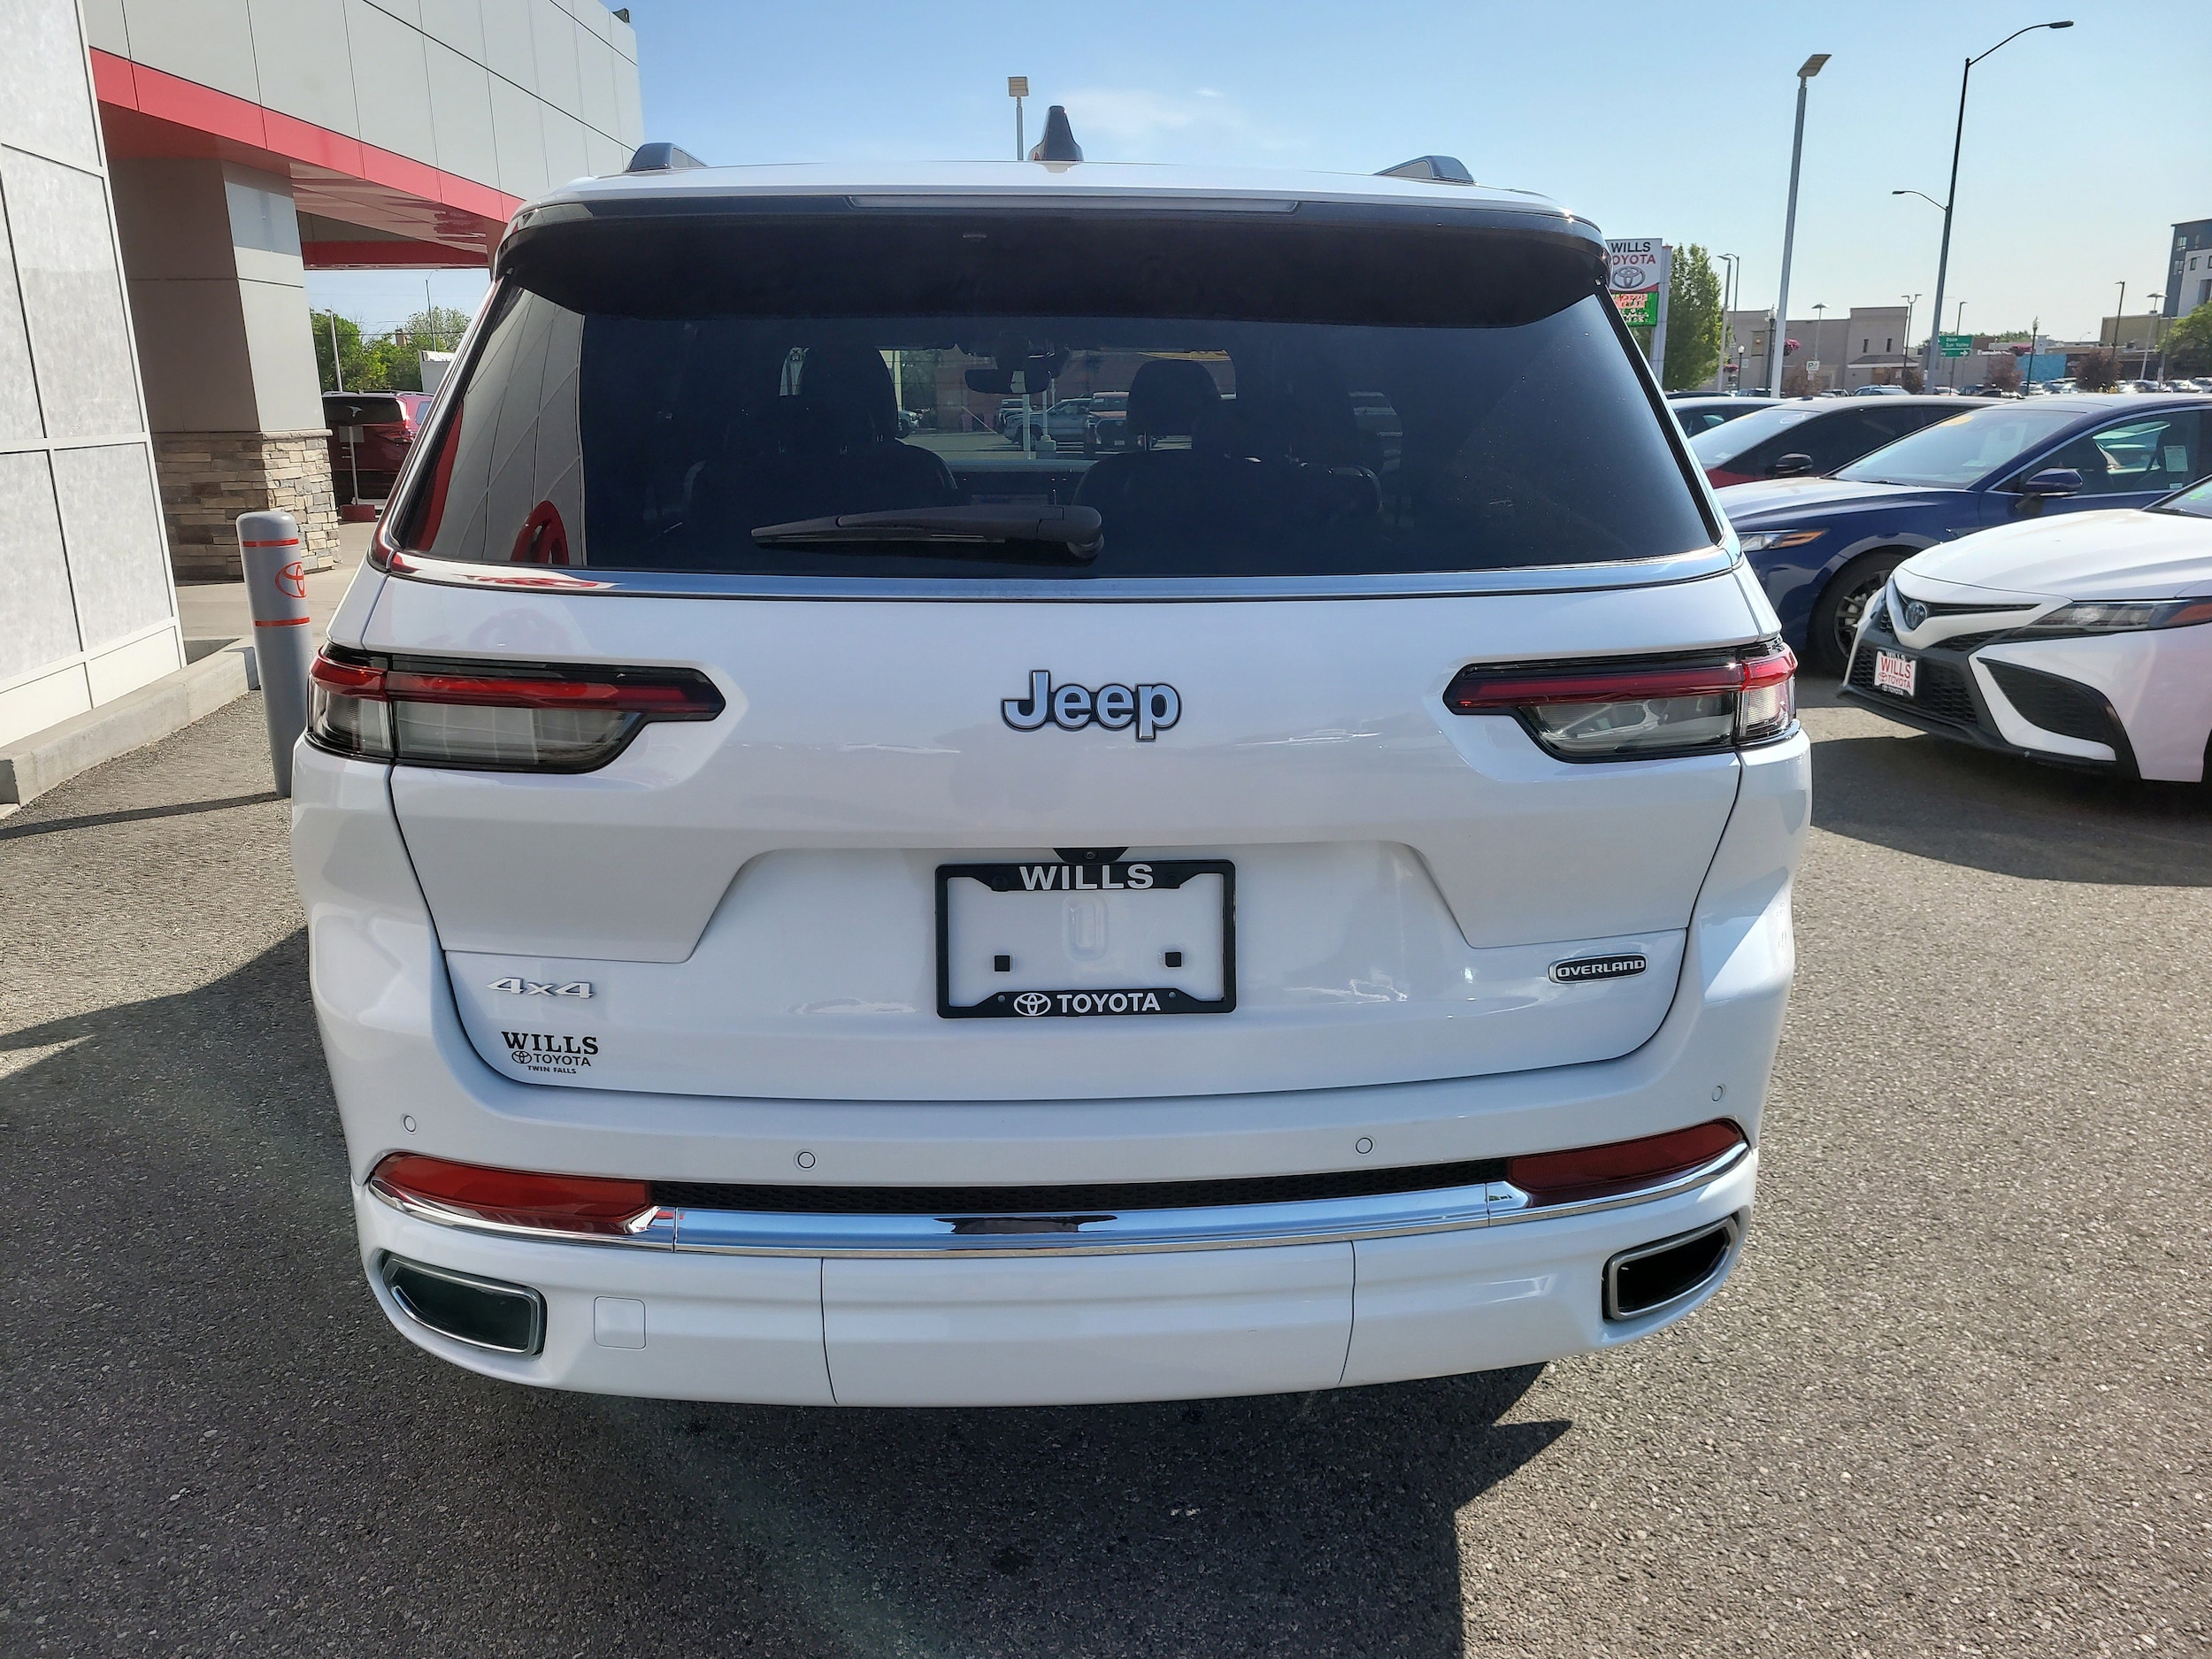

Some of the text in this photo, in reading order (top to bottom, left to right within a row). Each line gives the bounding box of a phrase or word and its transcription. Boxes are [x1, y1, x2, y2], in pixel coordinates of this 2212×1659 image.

[1611, 242, 1651, 253] WILLS
[1611, 254, 1655, 265] OYOTA
[1881, 657, 1911, 679] WILLS
[1887, 674, 1911, 689] TOYOTA
[1001, 670, 1182, 742] Jeep
[1018, 864, 1154, 891] WILLS
[1556, 960, 1645, 978] OVERLAND
[487, 976, 595, 999] 4x4
[1056, 992, 1162, 1014] TOYOTA
[501, 1031, 599, 1056] WILLS
[533, 1053, 592, 1067] TOYOTA
